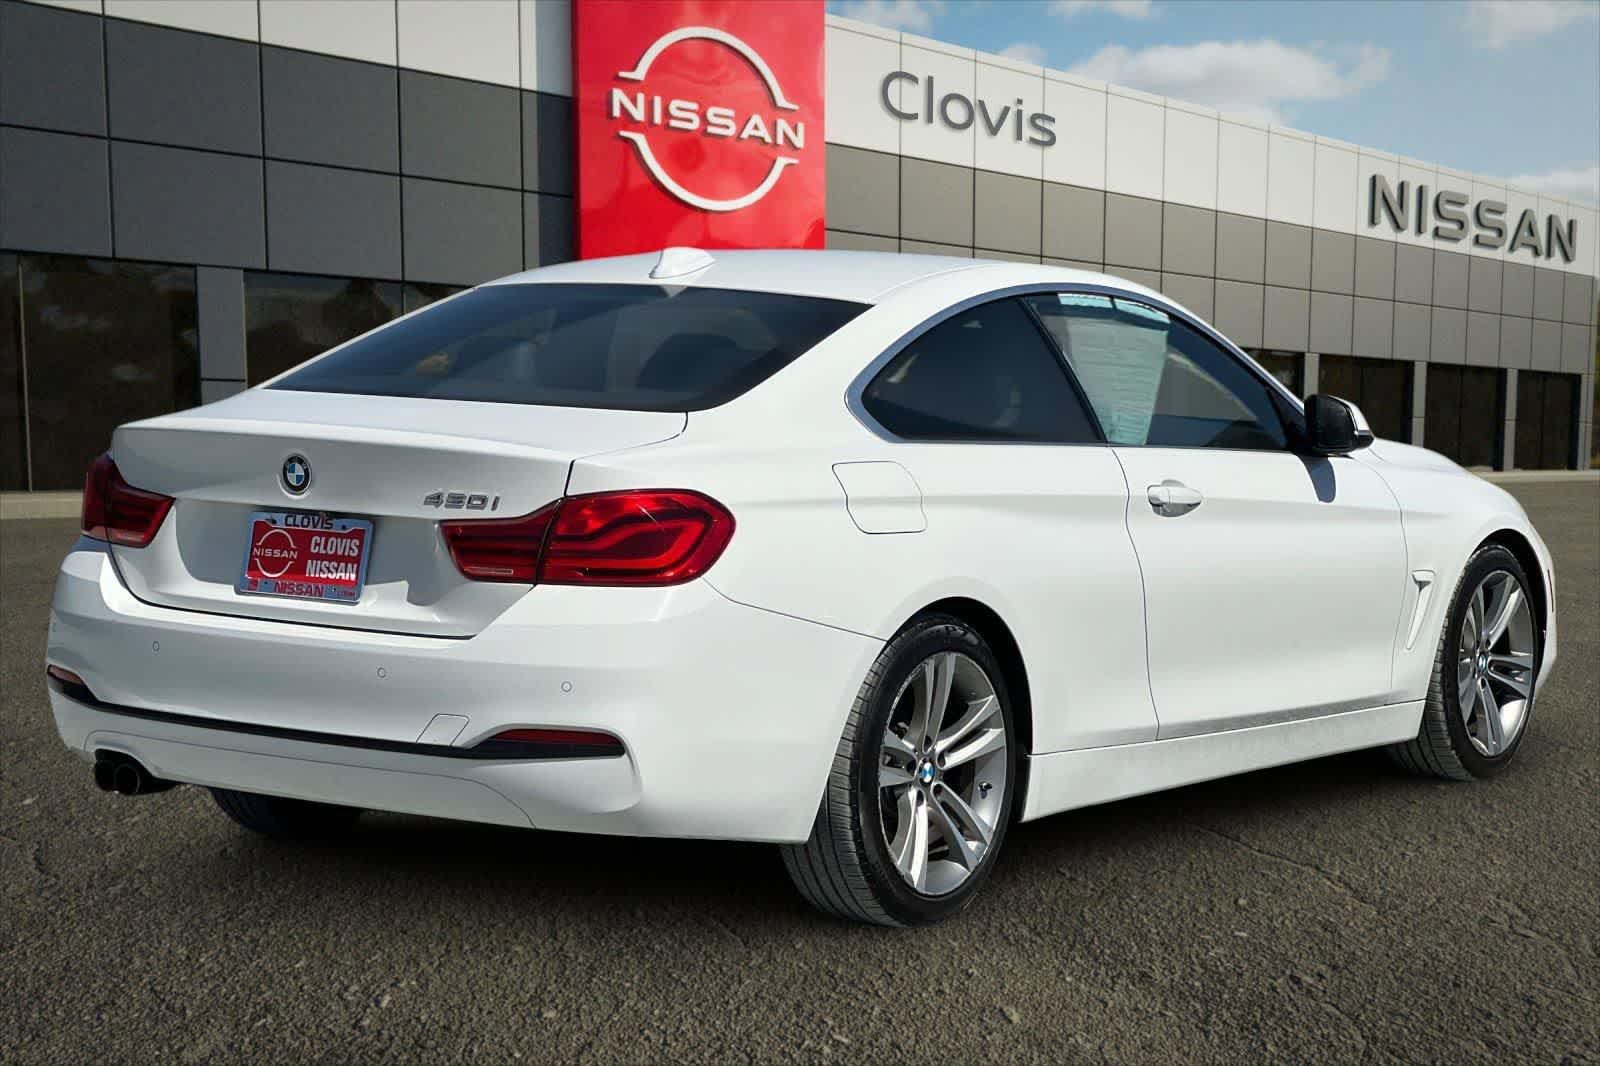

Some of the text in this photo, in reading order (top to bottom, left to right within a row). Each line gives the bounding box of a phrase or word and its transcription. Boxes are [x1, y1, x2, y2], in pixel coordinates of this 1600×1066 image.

[611, 87, 805, 150] NISSAN
[881, 71, 1057, 146] Clovis
[1368, 173, 1578, 263] NISSAN
[284, 514, 334, 530] CLOVIS
[252, 547, 298, 559] NISSAN
[310, 536, 360, 557] CLOVIS
[305, 559, 358, 581] NISSAN
[274, 580, 324, 597] NISSAN
